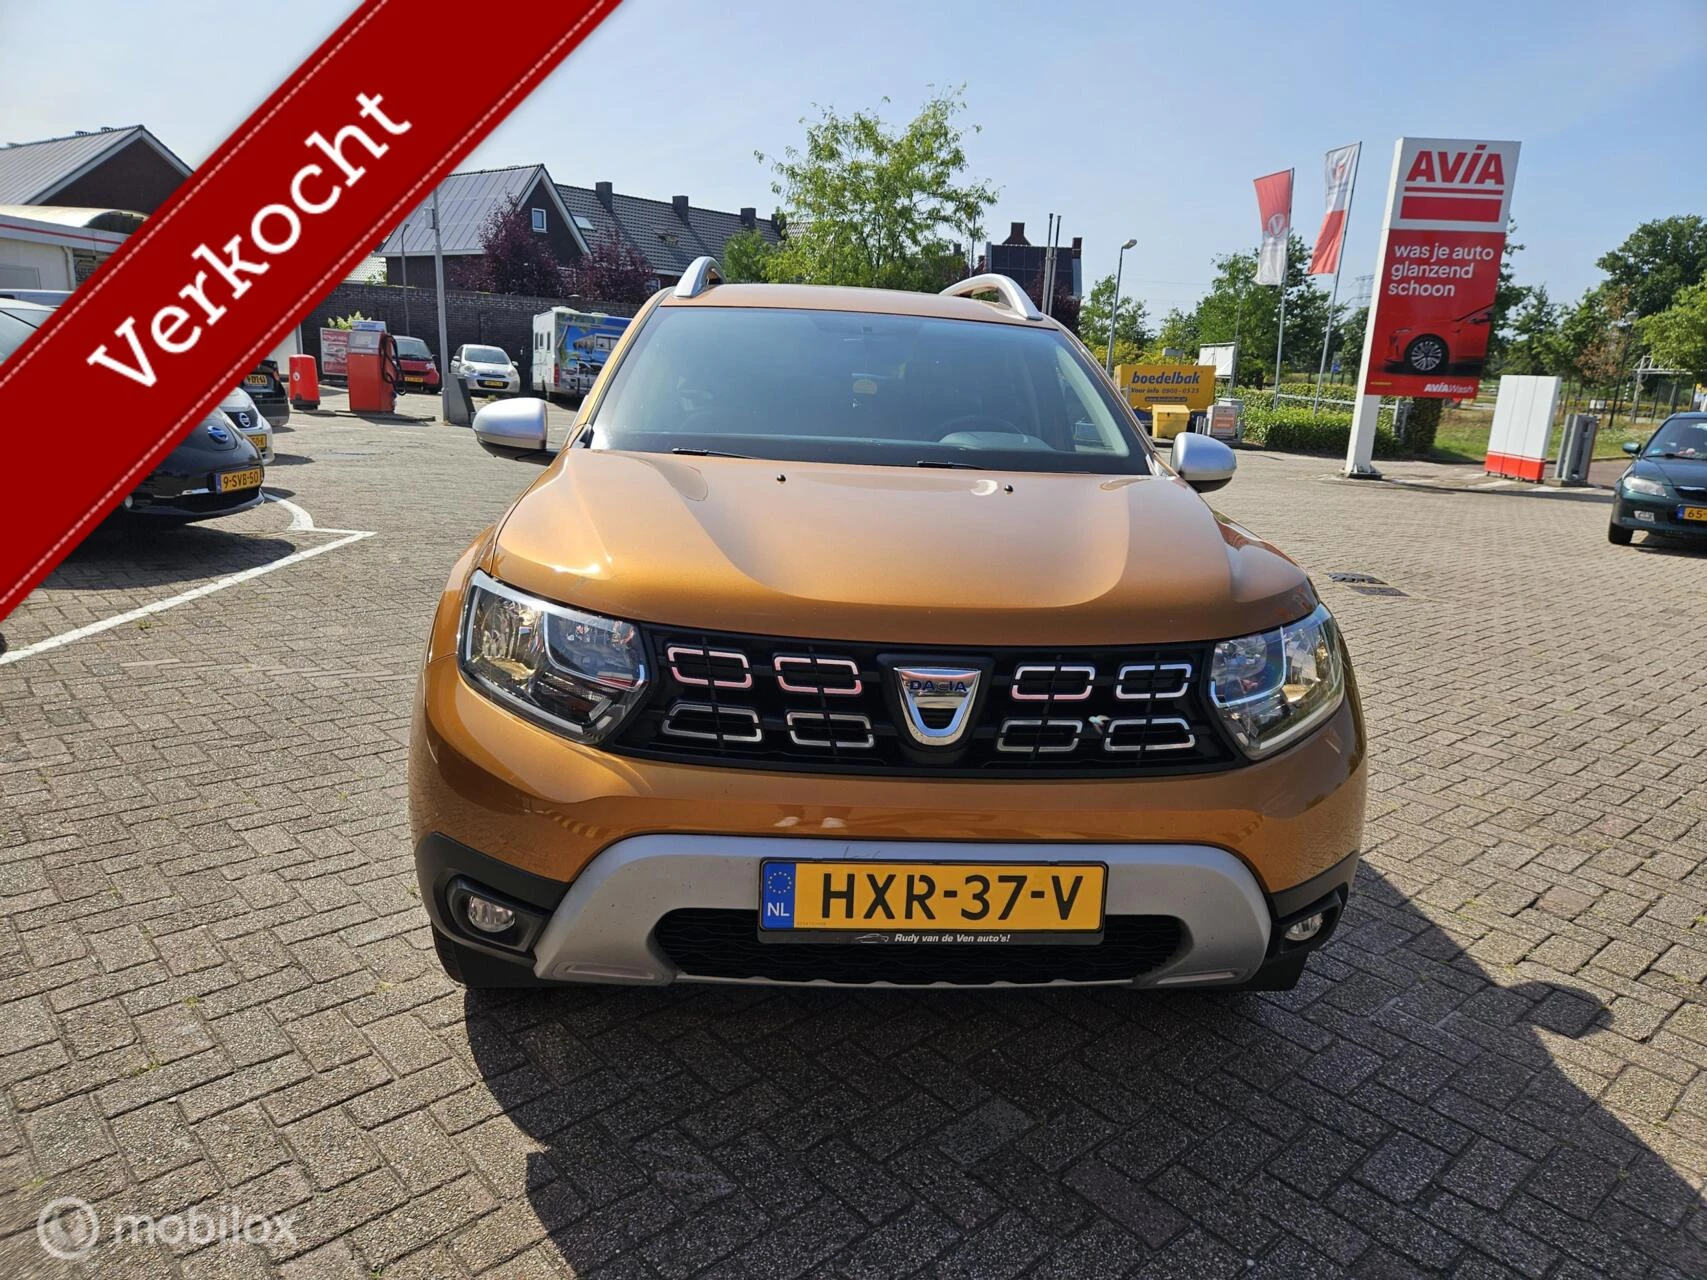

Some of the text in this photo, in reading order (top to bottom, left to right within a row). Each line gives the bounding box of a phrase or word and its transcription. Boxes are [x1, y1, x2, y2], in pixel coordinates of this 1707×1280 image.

[1406, 144, 1504, 185] AVIA
[1394, 242, 1494, 262] was je auto
[1391, 261, 1474, 280] glanzend
[1388, 280, 1455, 296] schoon
[1132, 371, 1200, 384] boedelbak
[223, 471, 259, 488] 9-SVB-50
[910, 680, 967, 691] DACIA
[822, 873, 1083, 920] HXR-37-V
[767, 902, 789, 916] NL
[895, 934, 919, 943] Rudy
[941, 934, 954, 942] de
[957, 934, 974, 942] Ven
[977, 934, 1010, 942] auto's!
